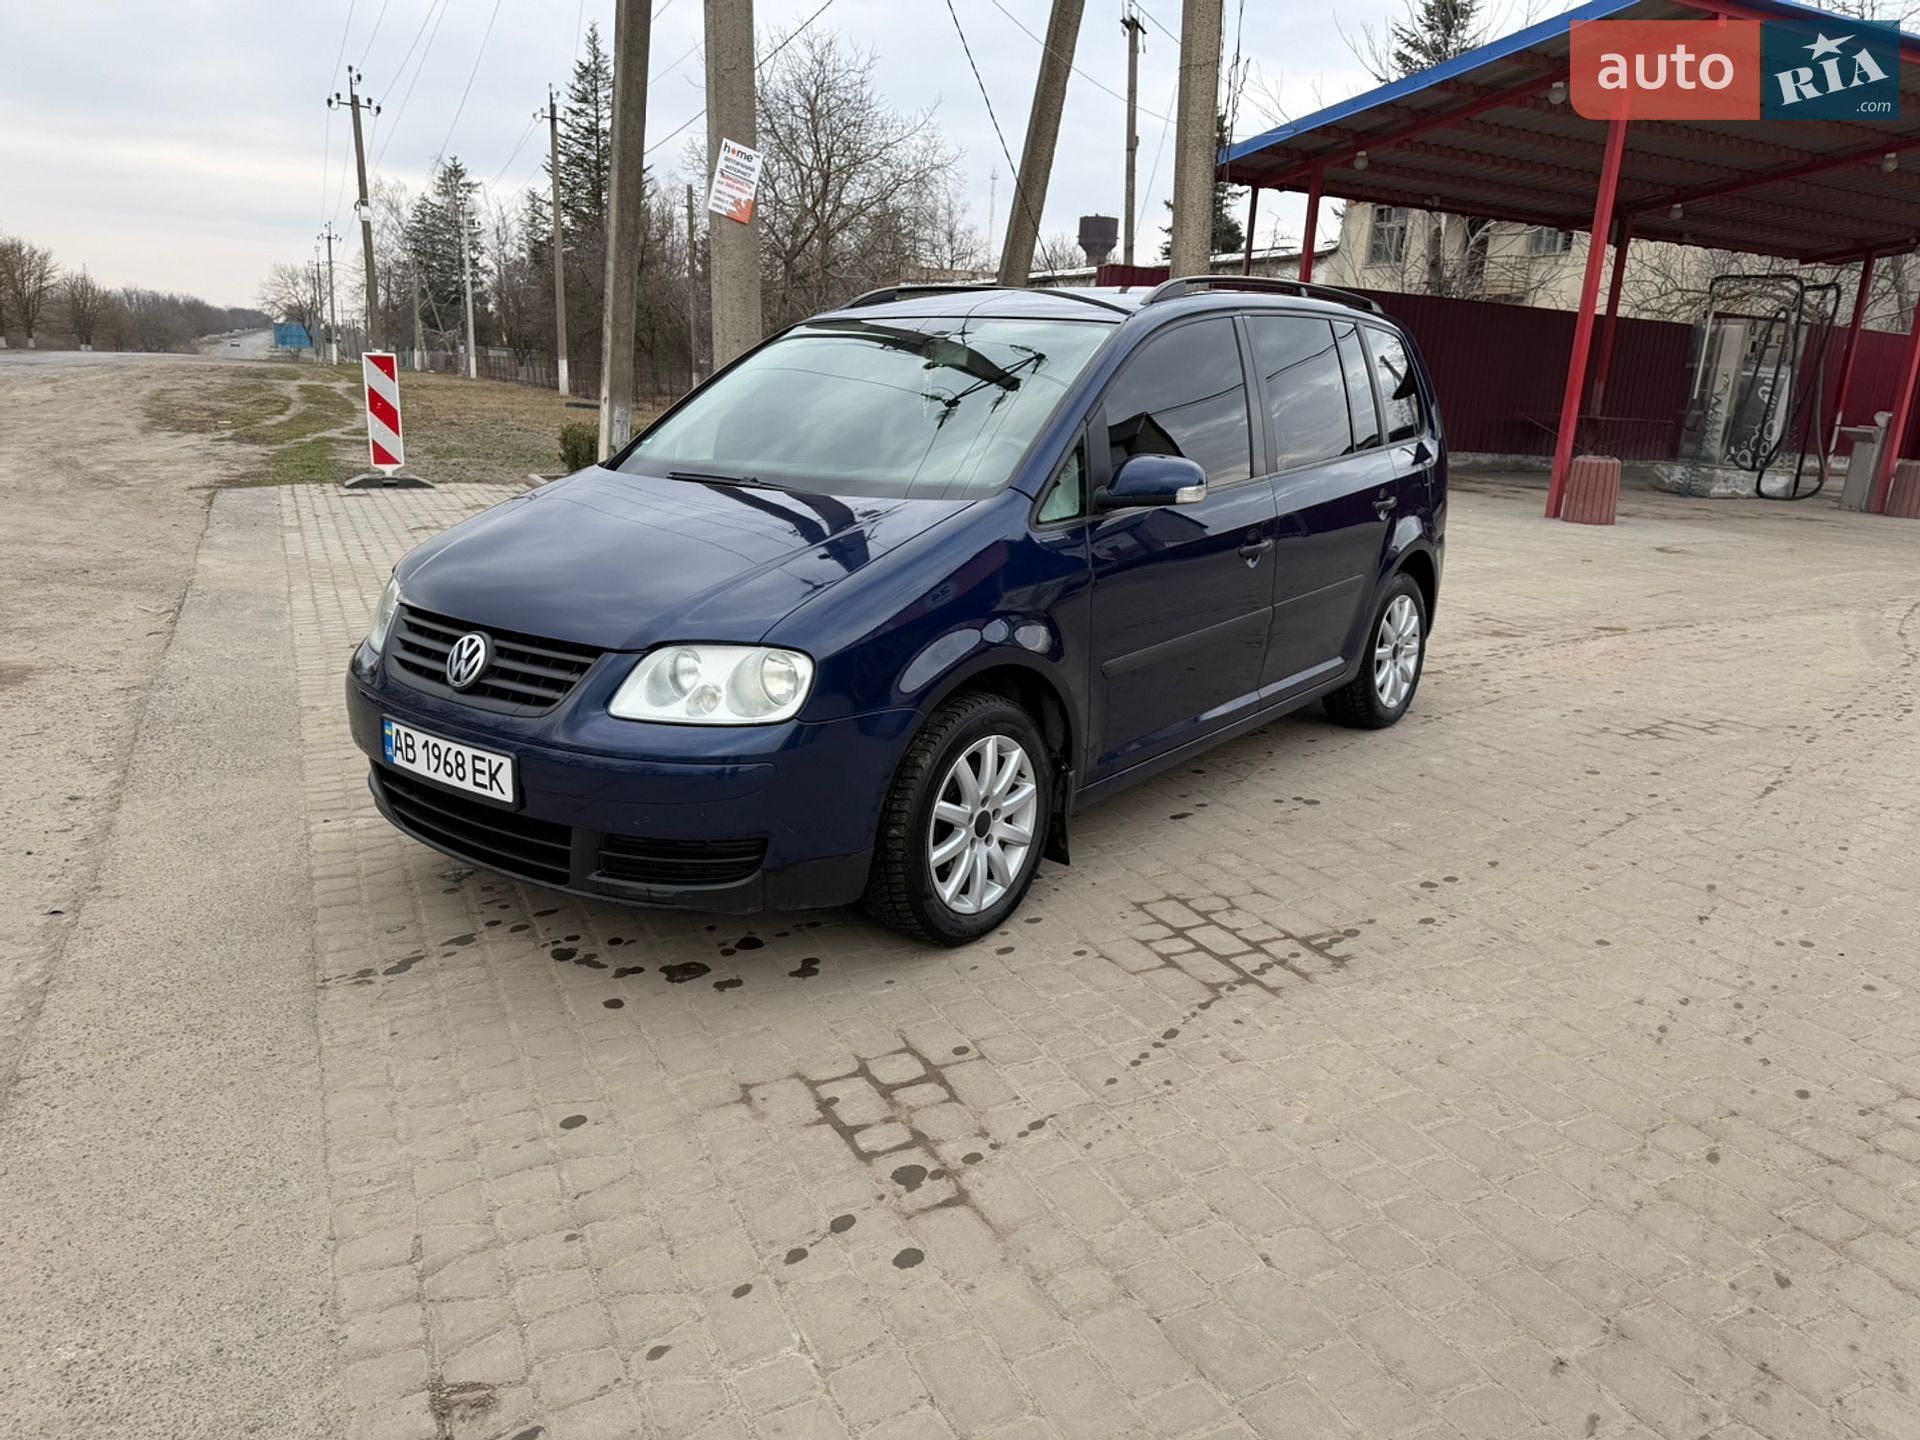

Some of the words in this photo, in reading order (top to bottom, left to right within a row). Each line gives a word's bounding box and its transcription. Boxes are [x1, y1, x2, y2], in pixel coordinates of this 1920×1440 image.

[723, 141, 754, 163] home
[394, 728, 417, 764] AB
[422, 740, 466, 782] 1968
[471, 754, 505, 795] EK
